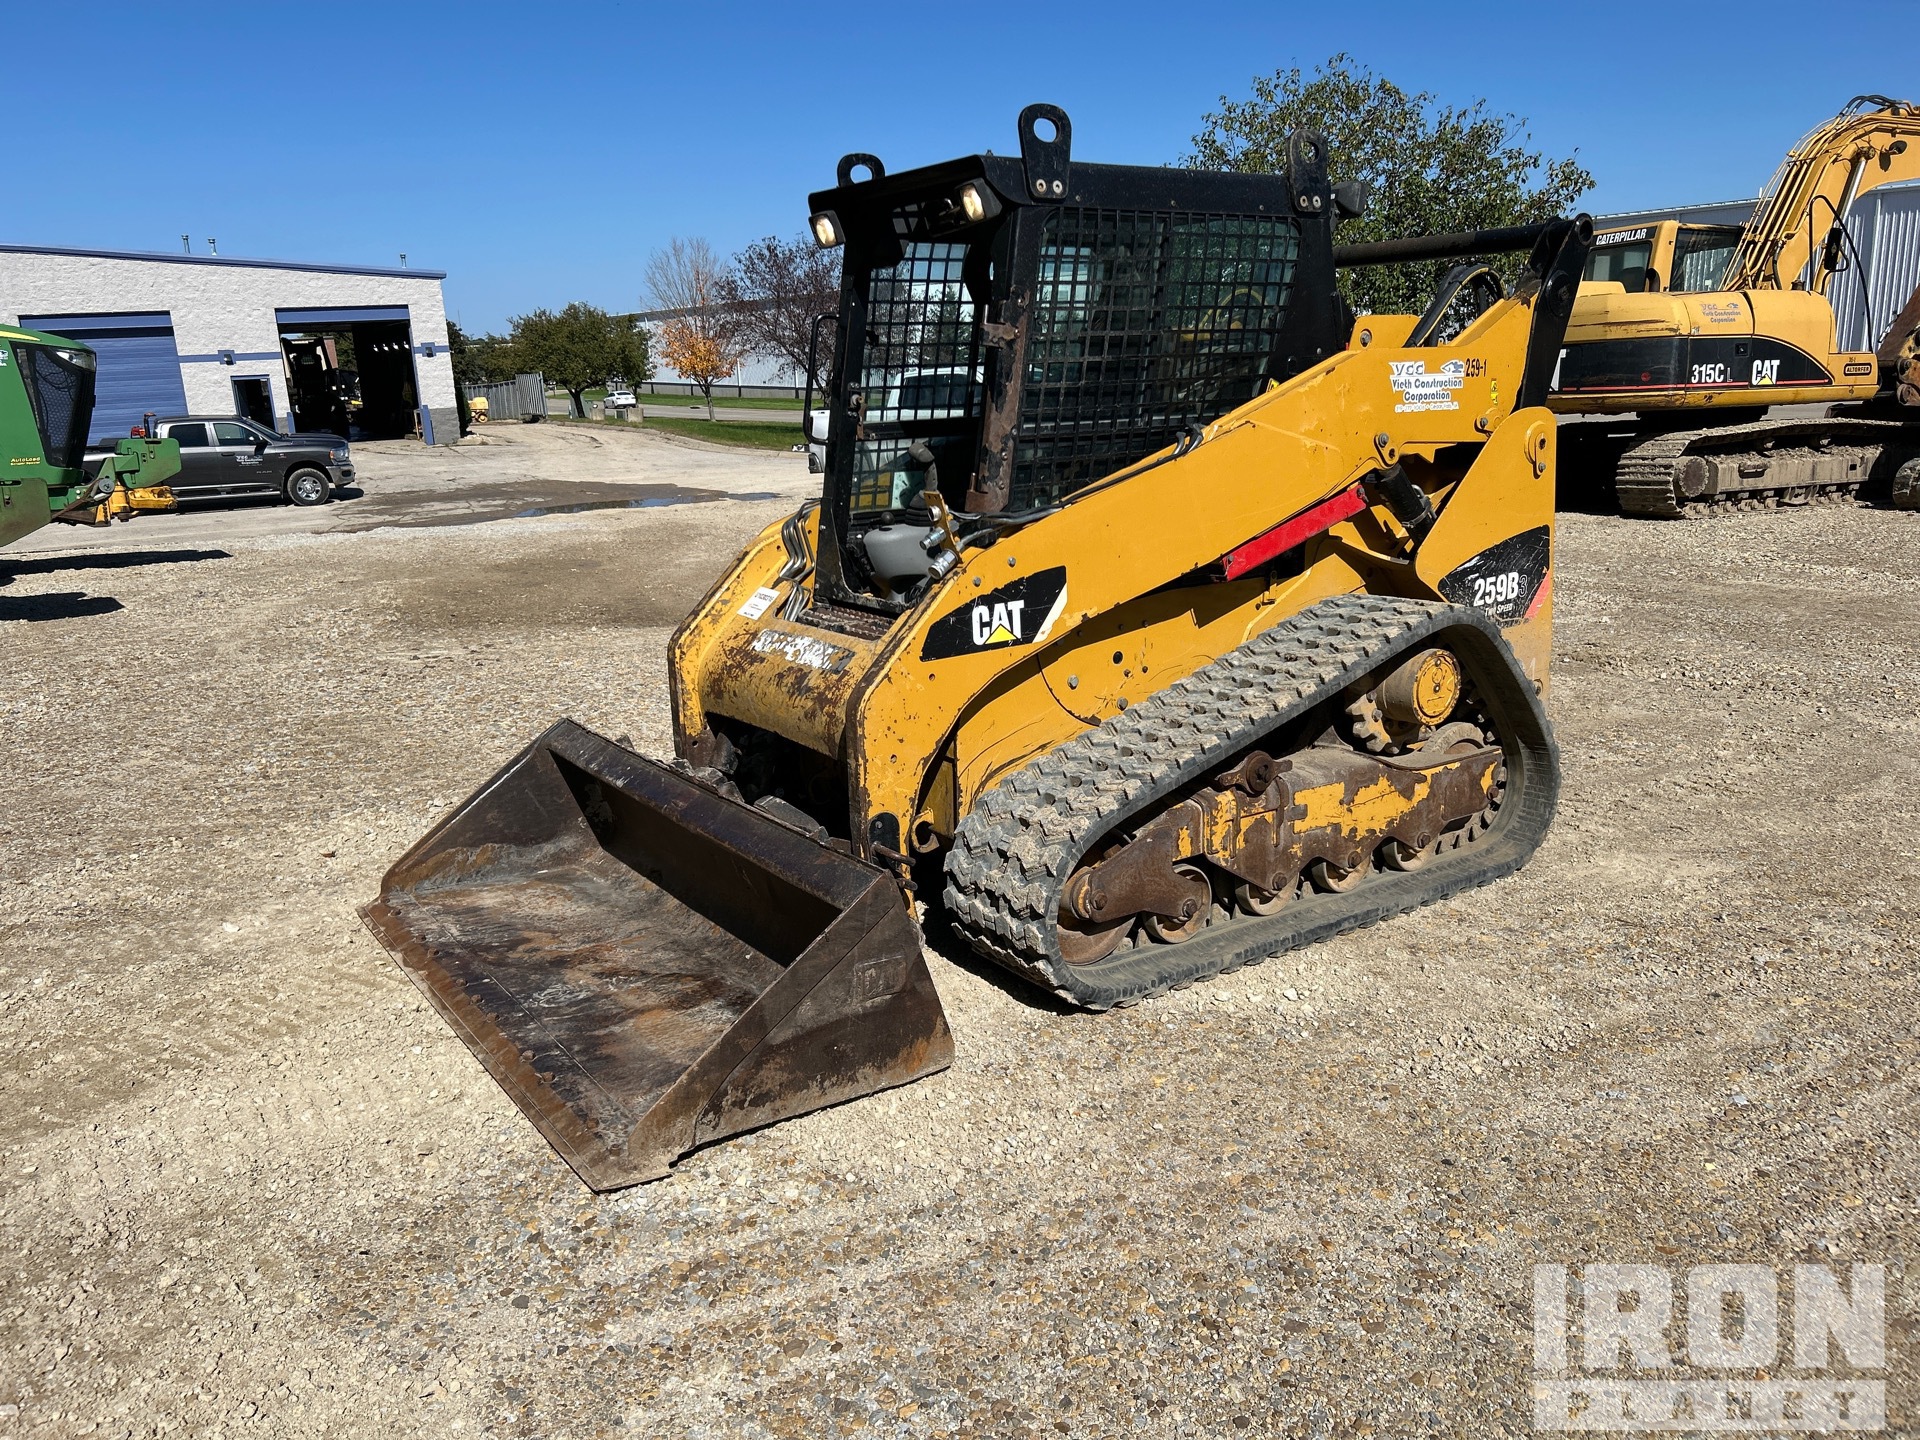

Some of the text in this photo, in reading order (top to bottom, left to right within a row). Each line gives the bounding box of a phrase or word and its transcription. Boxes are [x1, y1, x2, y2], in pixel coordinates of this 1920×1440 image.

[1596, 229, 1647, 245] CATERPILLAR
[1393, 363, 1424, 376] VCC
[1465, 358, 1487, 378] 259-1
[1691, 363, 1725, 383] 315C
[1751, 359, 1780, 386] CAT
[1392, 377, 1462, 389] Vieth Construction
[1404, 391, 1450, 403] Corporation
[971, 599, 1025, 646] CAT
